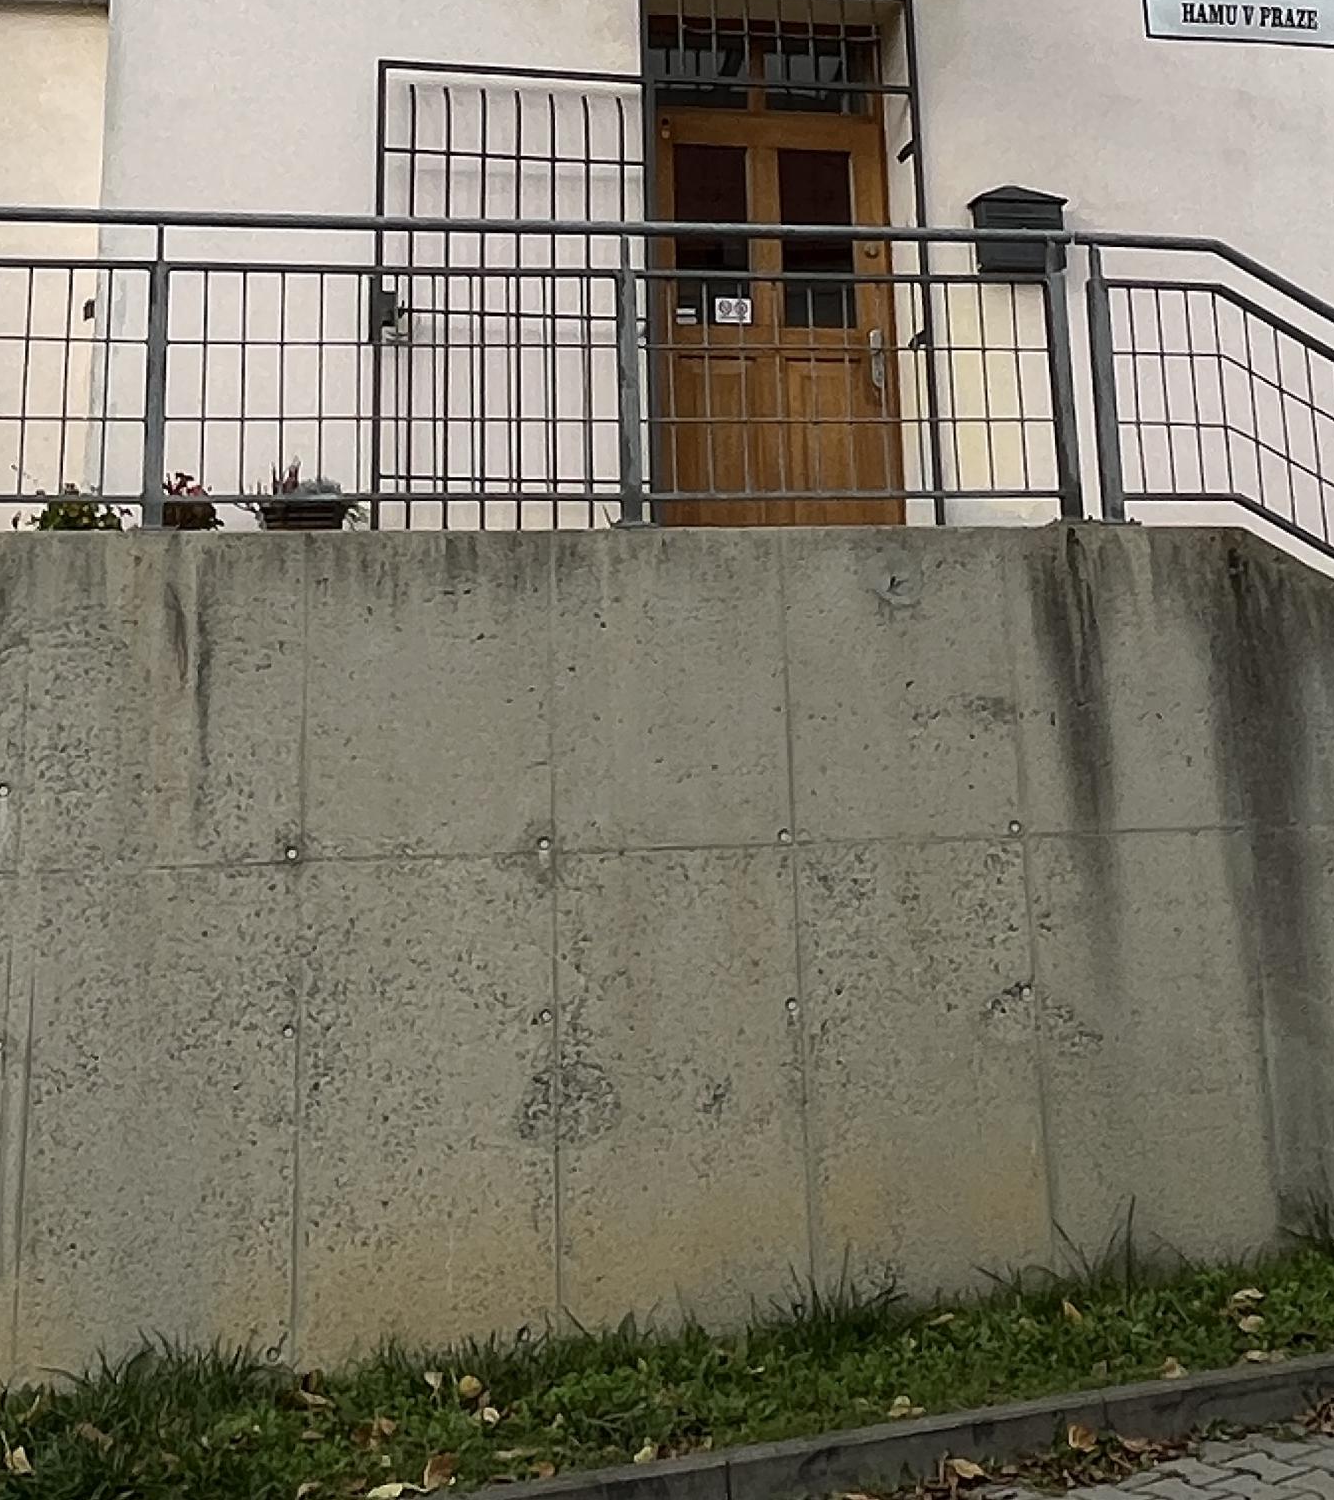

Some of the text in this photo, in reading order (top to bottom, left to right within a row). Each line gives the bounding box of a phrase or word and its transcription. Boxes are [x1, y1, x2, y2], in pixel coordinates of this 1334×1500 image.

[1181, 2, 1319, 30] HAMU V PRAZE
